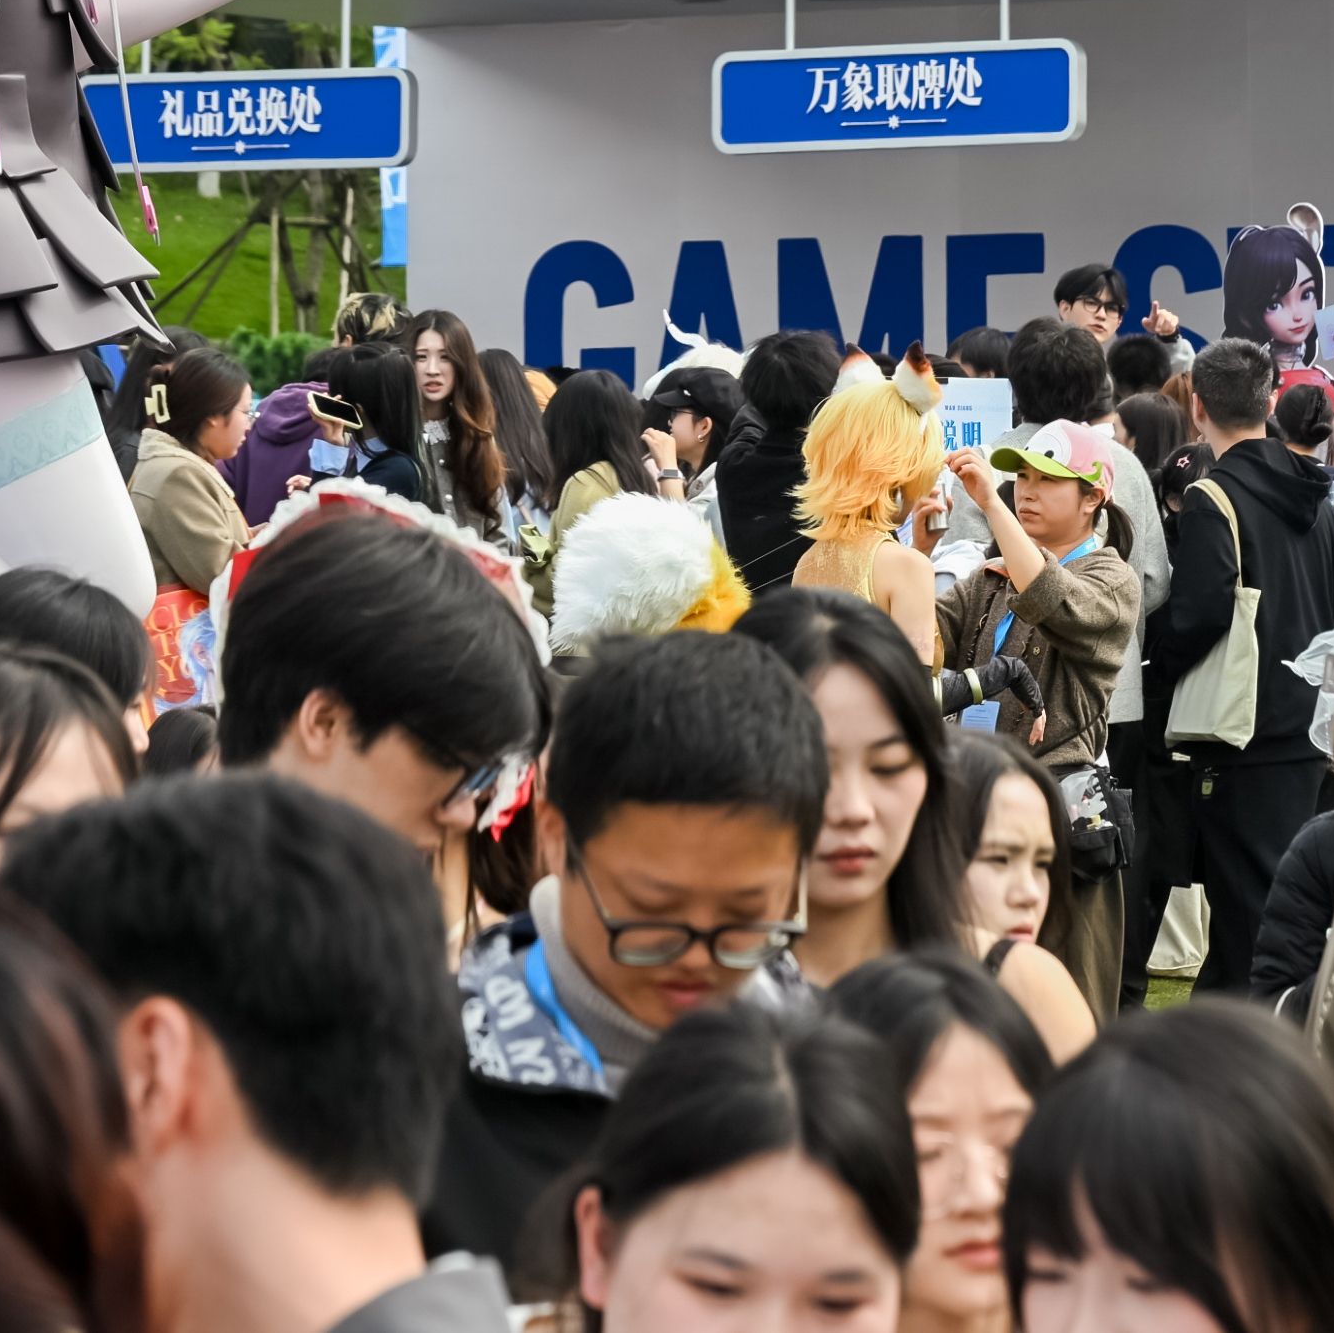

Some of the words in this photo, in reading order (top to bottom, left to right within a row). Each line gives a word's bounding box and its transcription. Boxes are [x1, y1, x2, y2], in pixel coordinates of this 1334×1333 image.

[158, 85, 323, 139] 礼品兑换处
[805, 56, 983, 115] 万象取牌处
